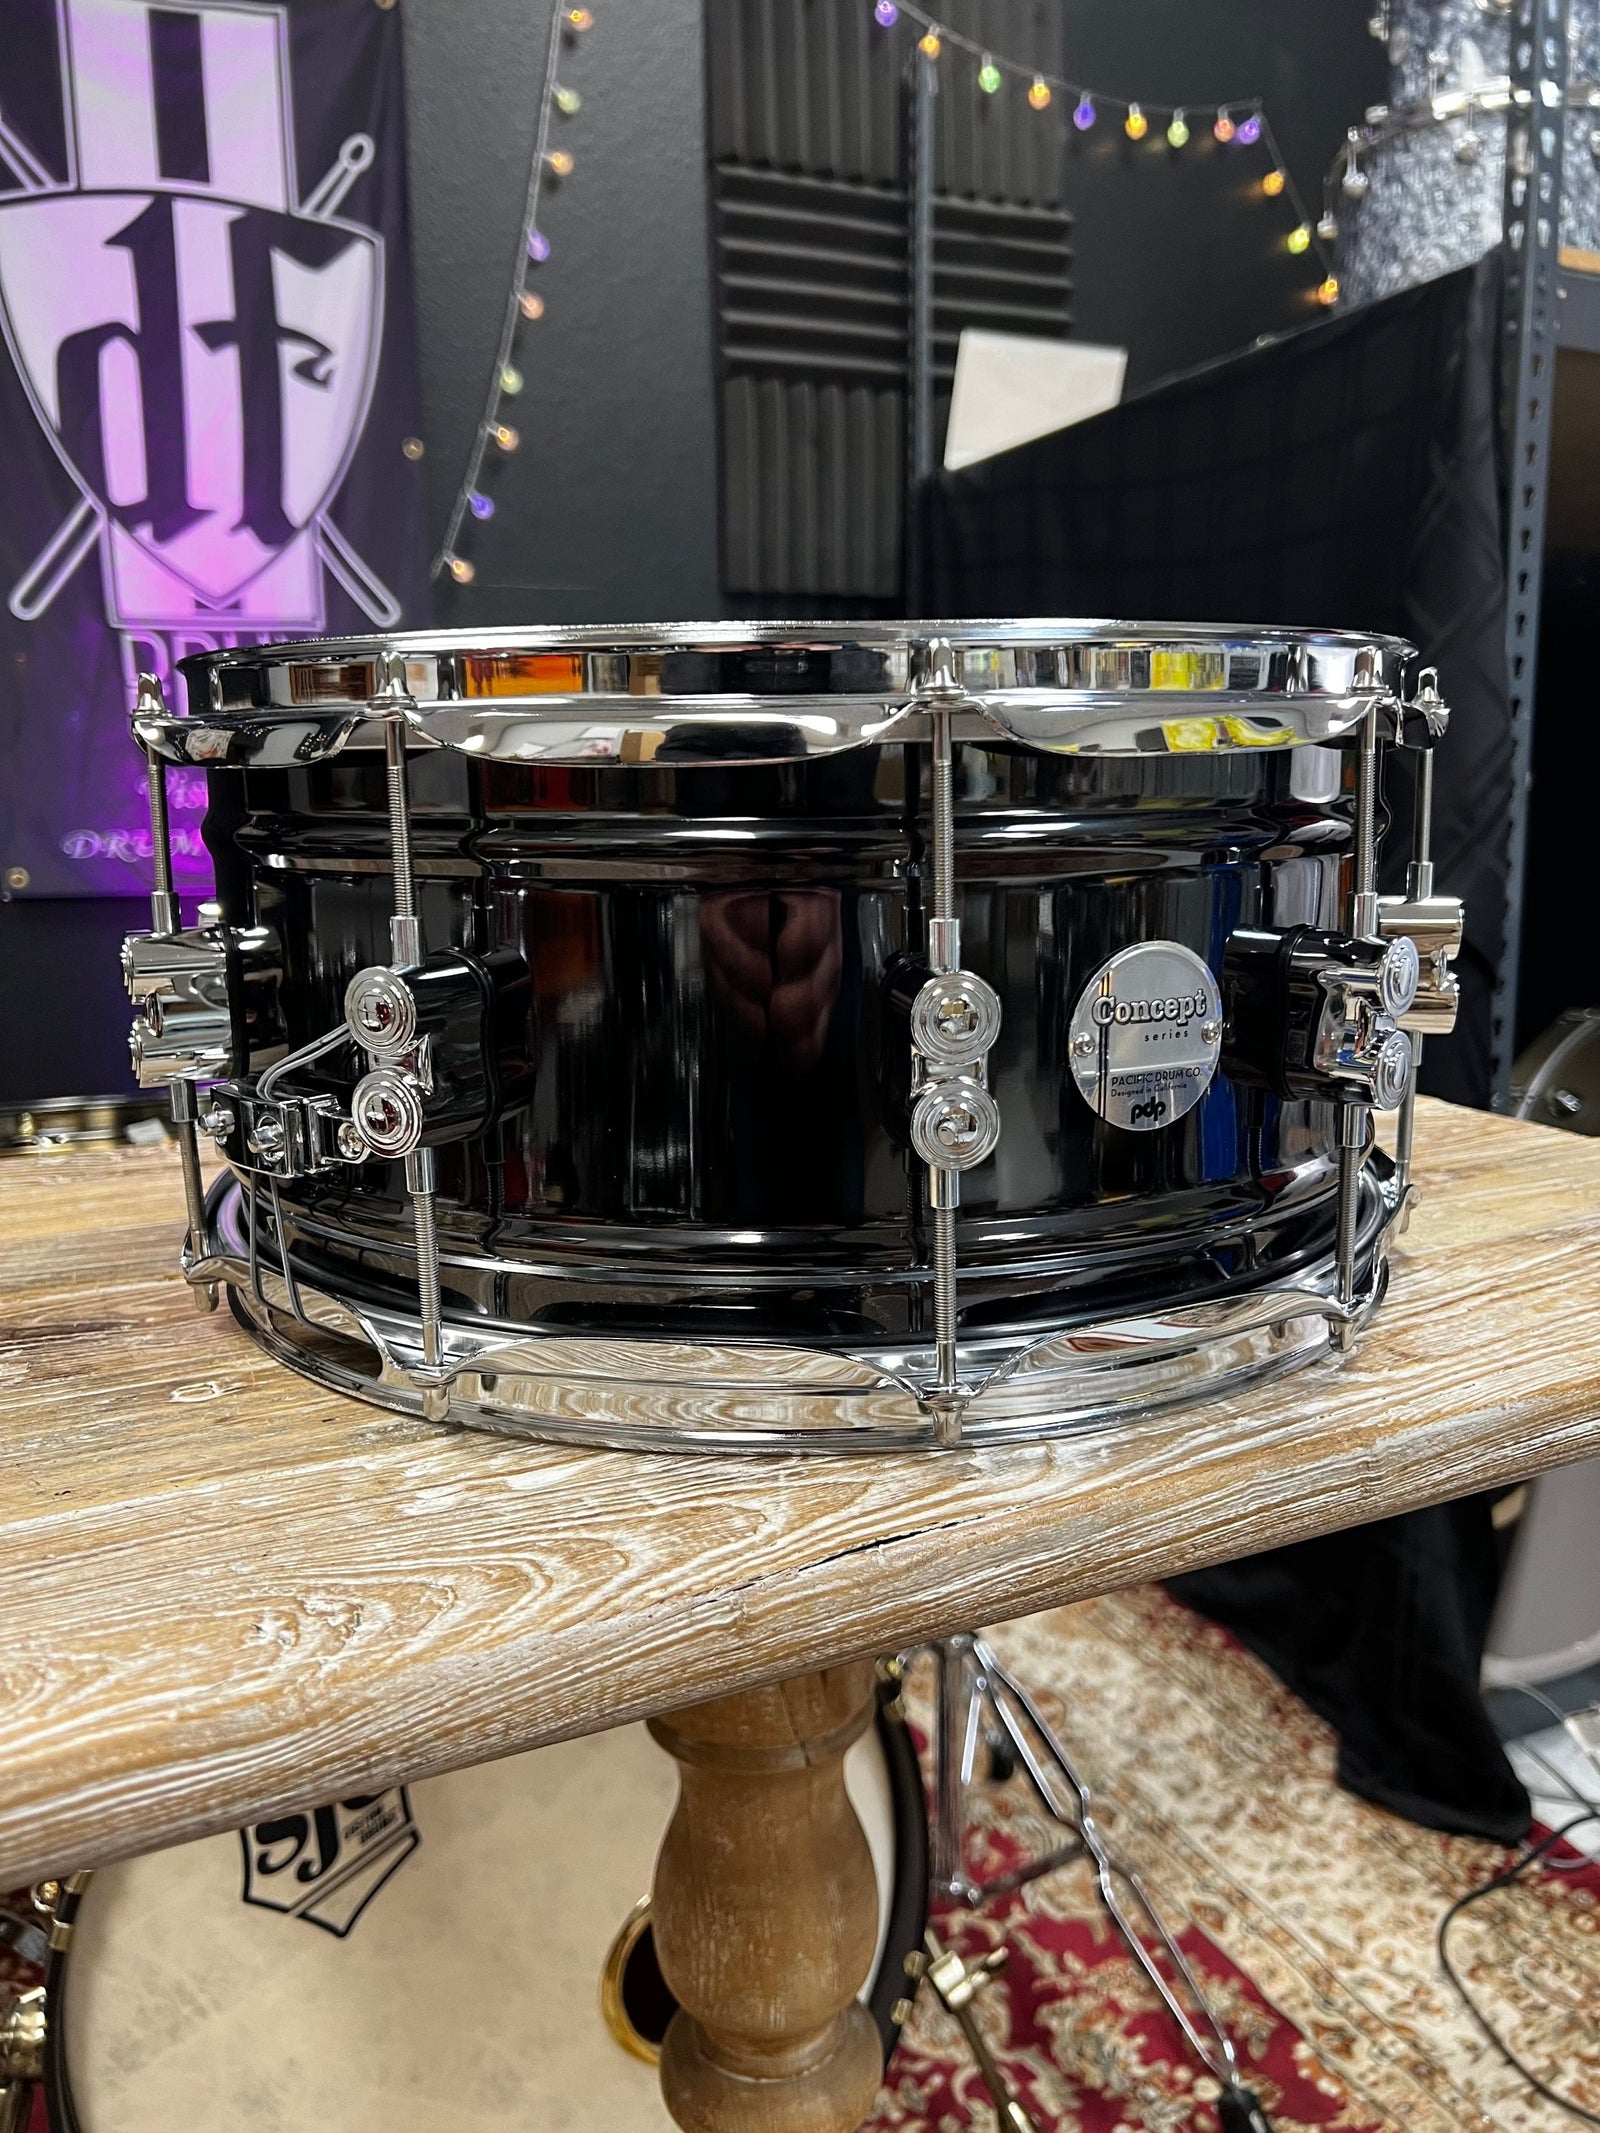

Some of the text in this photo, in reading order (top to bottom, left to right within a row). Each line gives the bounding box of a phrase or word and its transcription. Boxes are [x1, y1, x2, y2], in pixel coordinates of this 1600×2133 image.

[1092, 988, 1207, 1027] Concept
[1144, 1029, 1189, 1042] series
[1111, 1066, 1203, 1087] PACIFIC DRUM CO.
[1111, 1086, 1144, 1098] Designed
[1153, 1082, 1187, 1093] California
[1130, 1095, 1167, 1125] pdp
